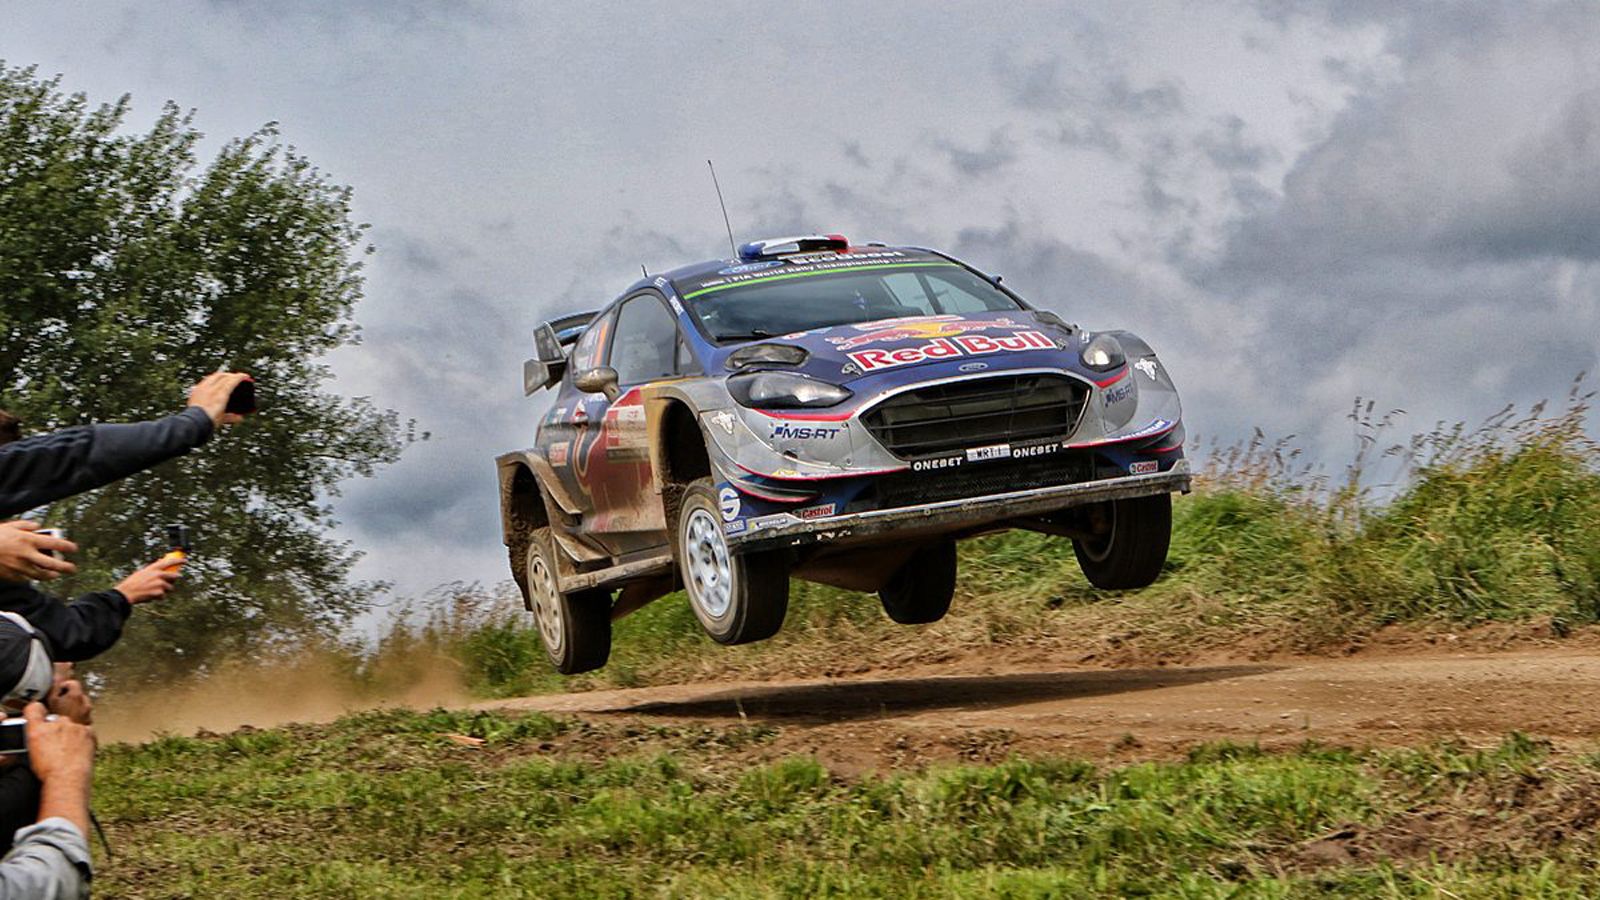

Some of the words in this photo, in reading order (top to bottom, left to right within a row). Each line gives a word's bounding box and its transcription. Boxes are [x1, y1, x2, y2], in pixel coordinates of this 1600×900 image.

[733, 273, 753, 282] FIA
[753, 266, 785, 278] World
[788, 261, 815, 273] Rally
[817, 257, 890, 270] Championship
[853, 338, 959, 370] Red
[957, 331, 1053, 354] Bull
[913, 456, 964, 472] ONEBET
[1012, 443, 1059, 459] ONEBET
[802, 504, 833, 519] Castrol
